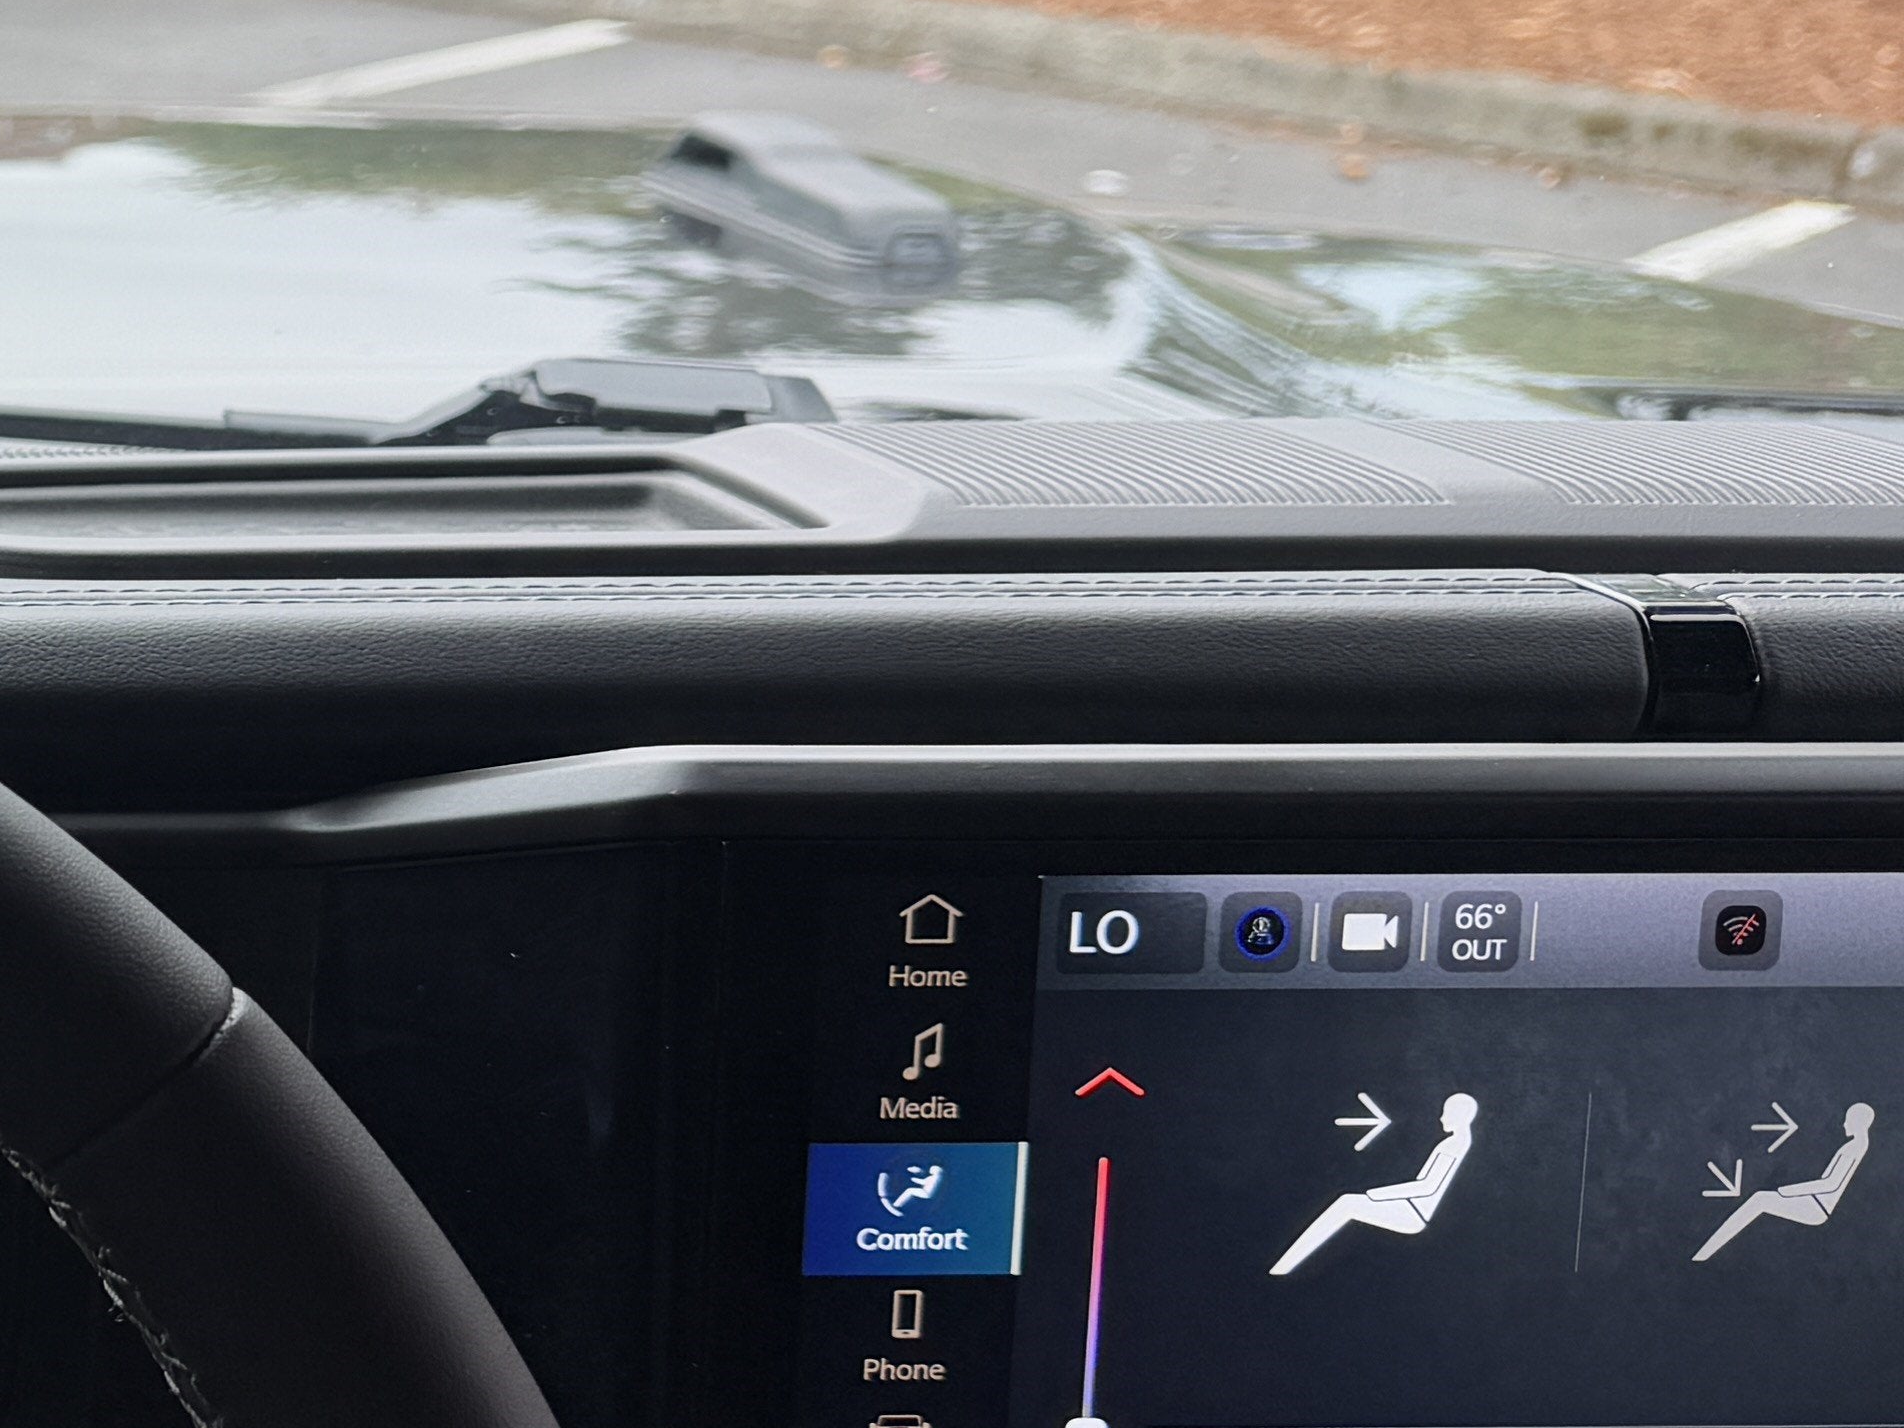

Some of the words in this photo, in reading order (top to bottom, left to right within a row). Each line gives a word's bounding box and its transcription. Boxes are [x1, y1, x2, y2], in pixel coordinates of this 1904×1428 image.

[1454, 904, 1507, 930] 66°
[1070, 910, 1140, 956] LO
[1452, 937, 1507, 962] OUT
[888, 964, 968, 989] Home
[880, 1095, 959, 1120] Media
[856, 1227, 969, 1253] Comfort
[863, 1358, 945, 1382] Phone
